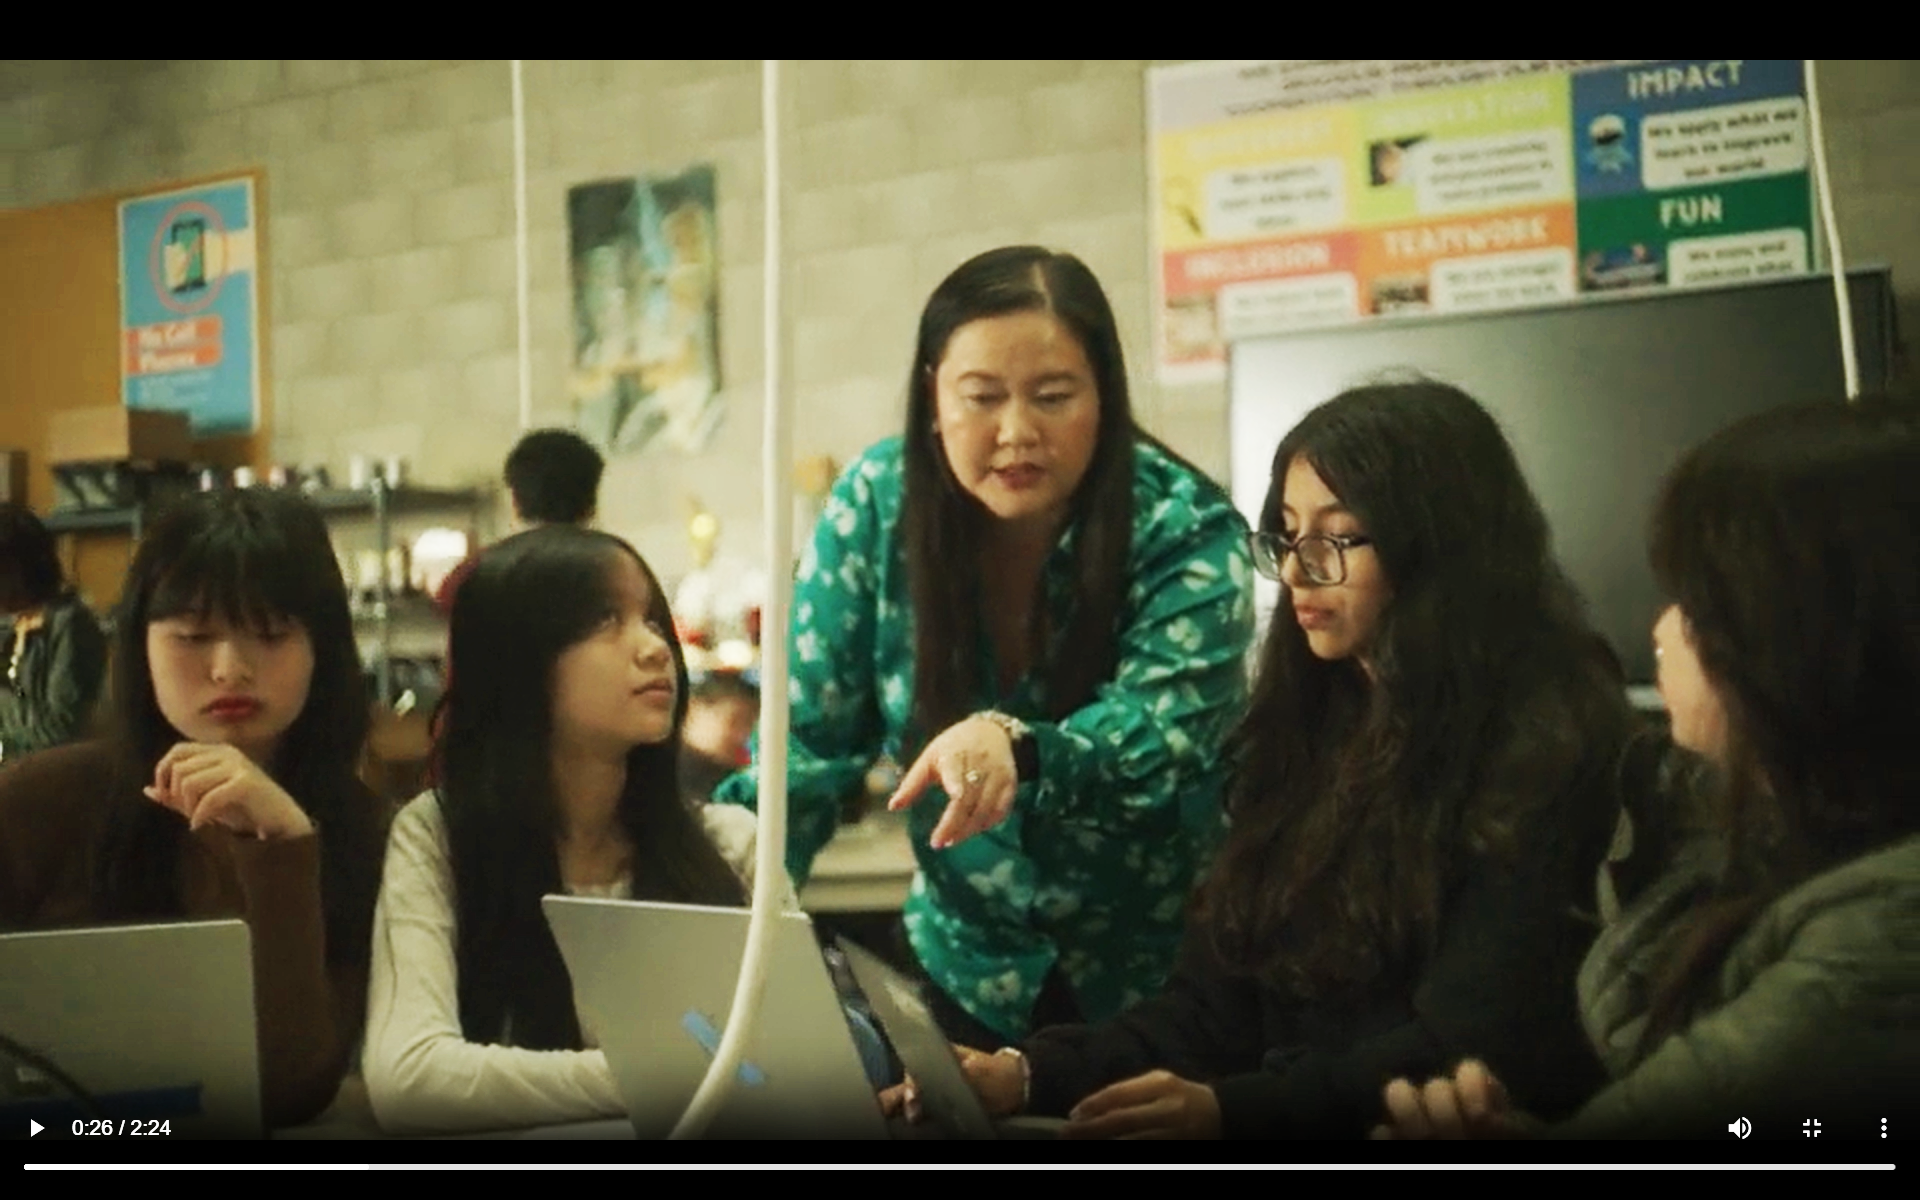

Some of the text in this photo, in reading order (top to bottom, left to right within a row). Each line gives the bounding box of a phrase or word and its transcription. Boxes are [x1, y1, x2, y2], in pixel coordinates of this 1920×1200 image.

[1628, 60, 1742, 99] IMPACT
[1659, 193, 1724, 229] FUN
[1383, 214, 1548, 257] TEAMWORK
